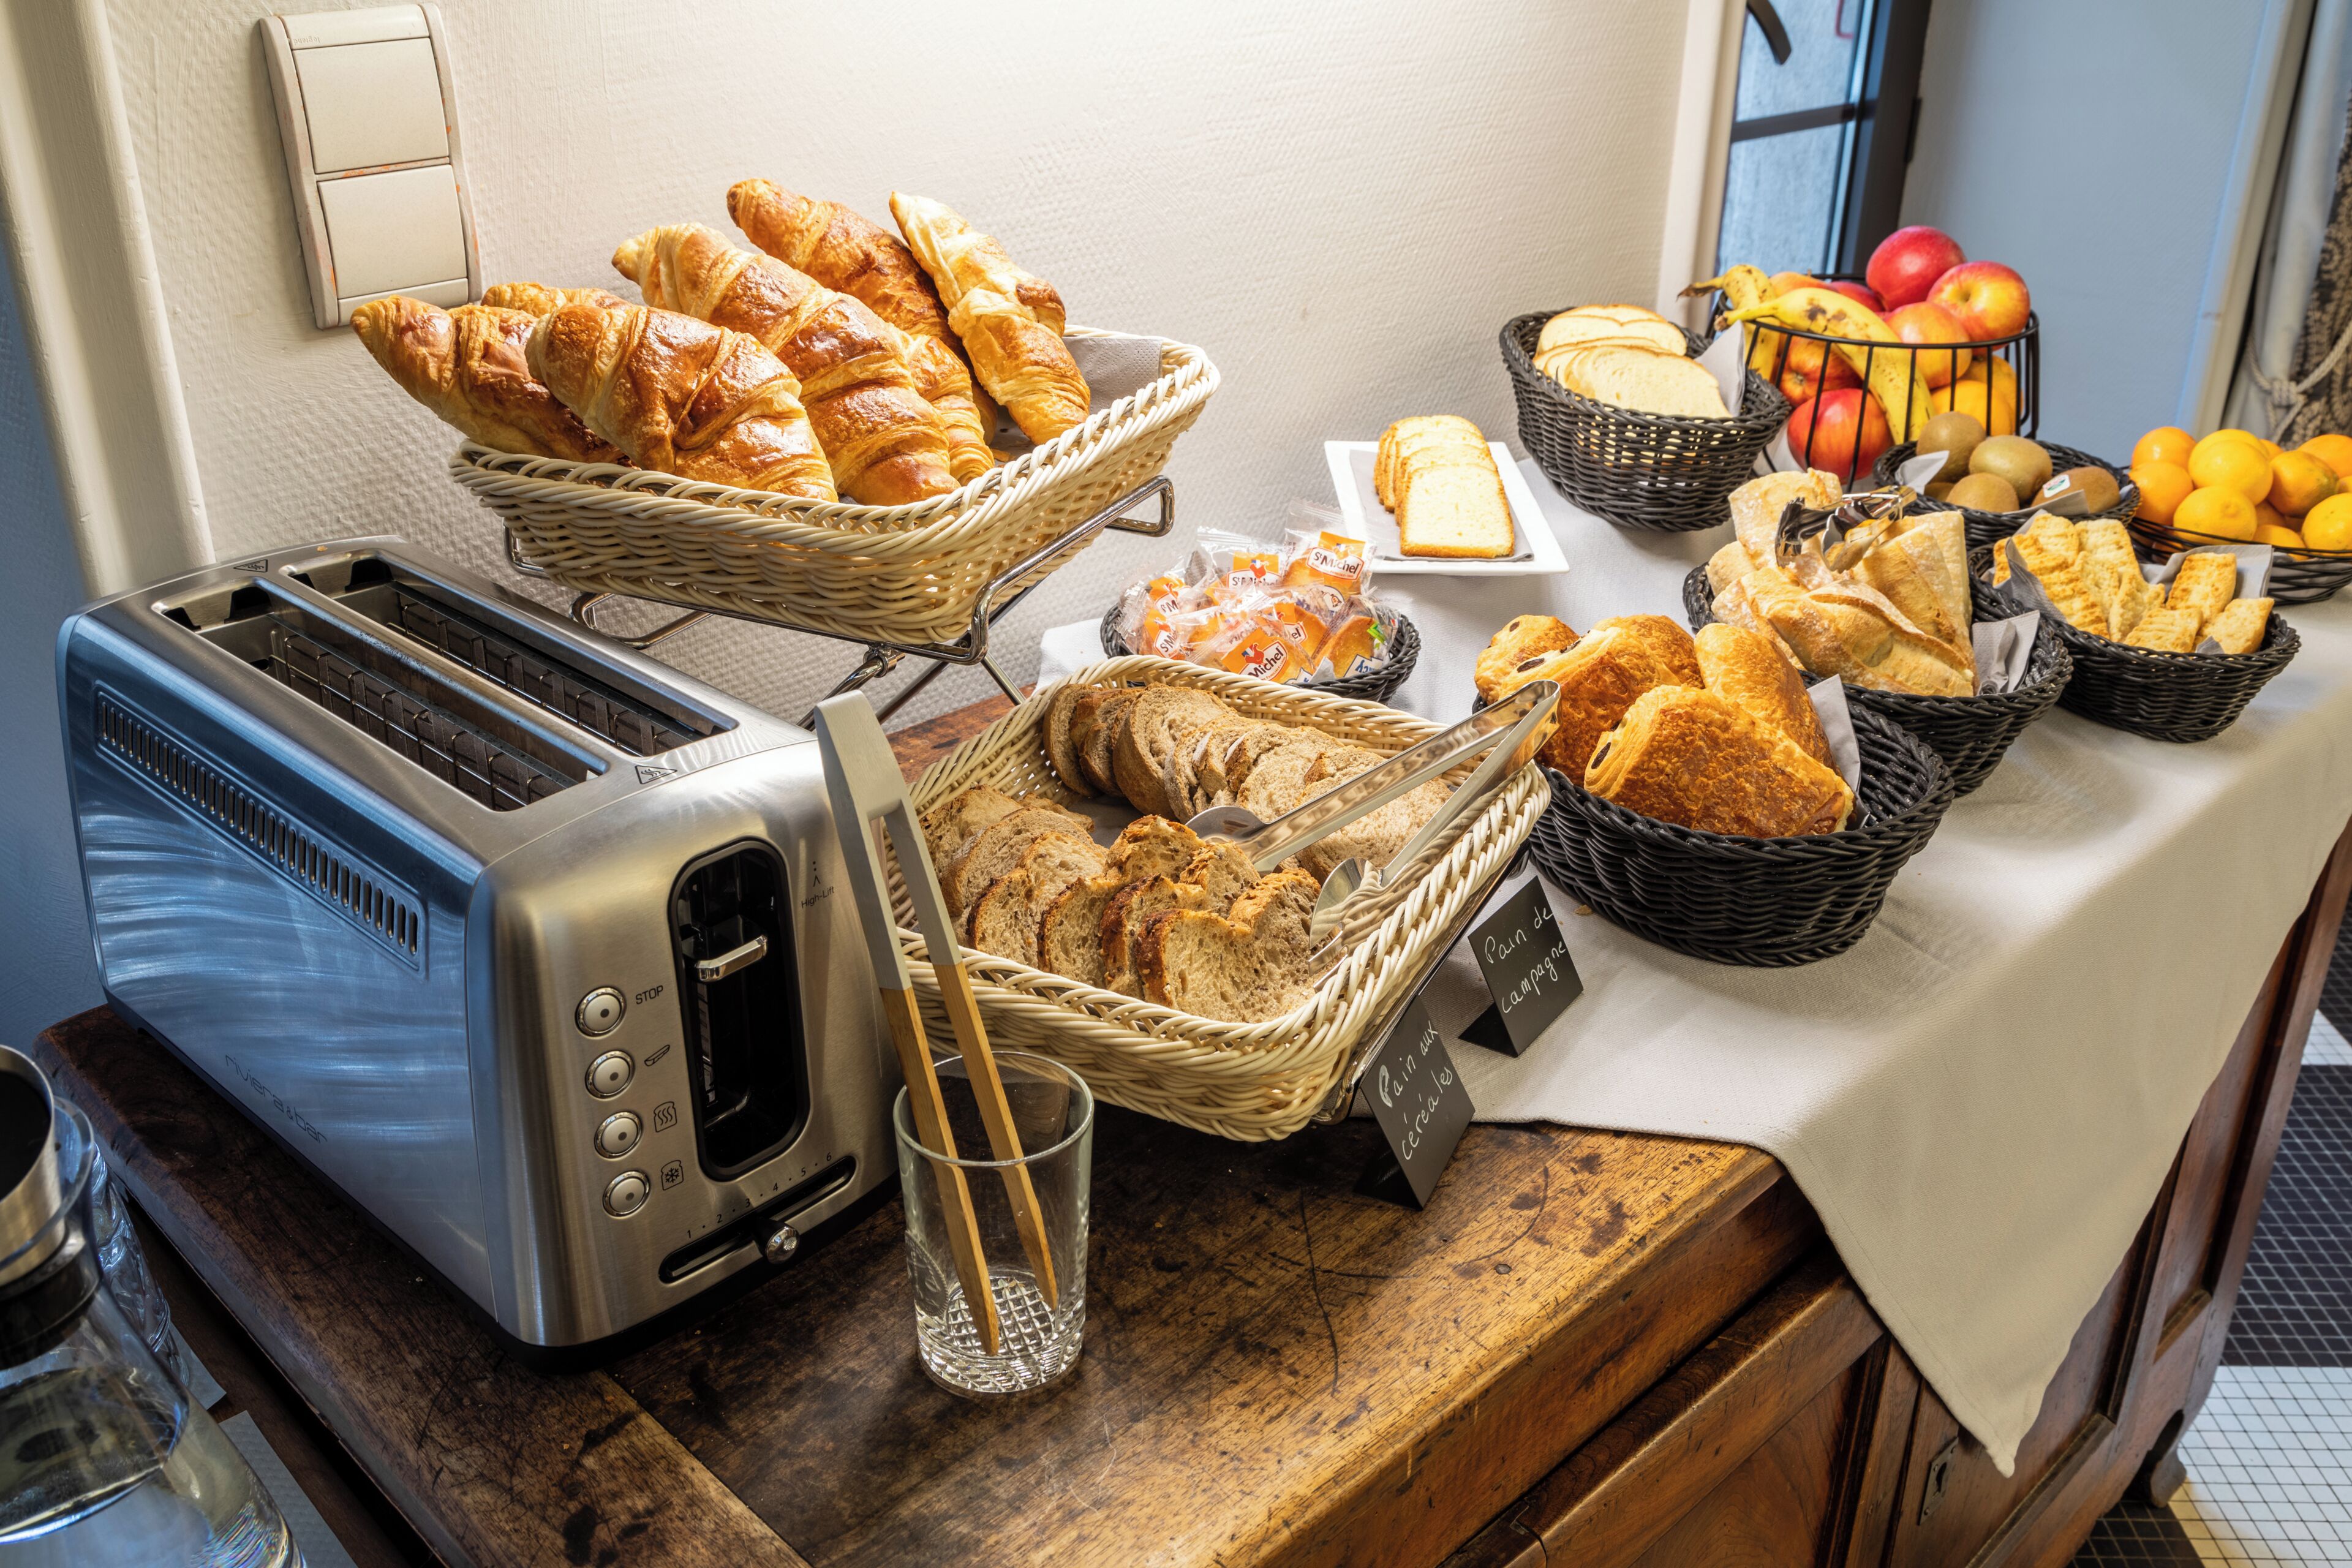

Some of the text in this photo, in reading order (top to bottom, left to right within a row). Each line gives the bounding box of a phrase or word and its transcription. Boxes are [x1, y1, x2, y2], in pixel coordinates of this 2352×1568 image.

[801, 886, 834, 908] High-Lift
[1485, 907, 1553, 963] Pain de
[636, 985, 663, 1005] STOP
[1379, 1020, 1438, 1107] Pain aux
[1402, 1067, 1452, 1159] céréales
[687, 1152, 832, 1238] 1 2 3 4 5 6
